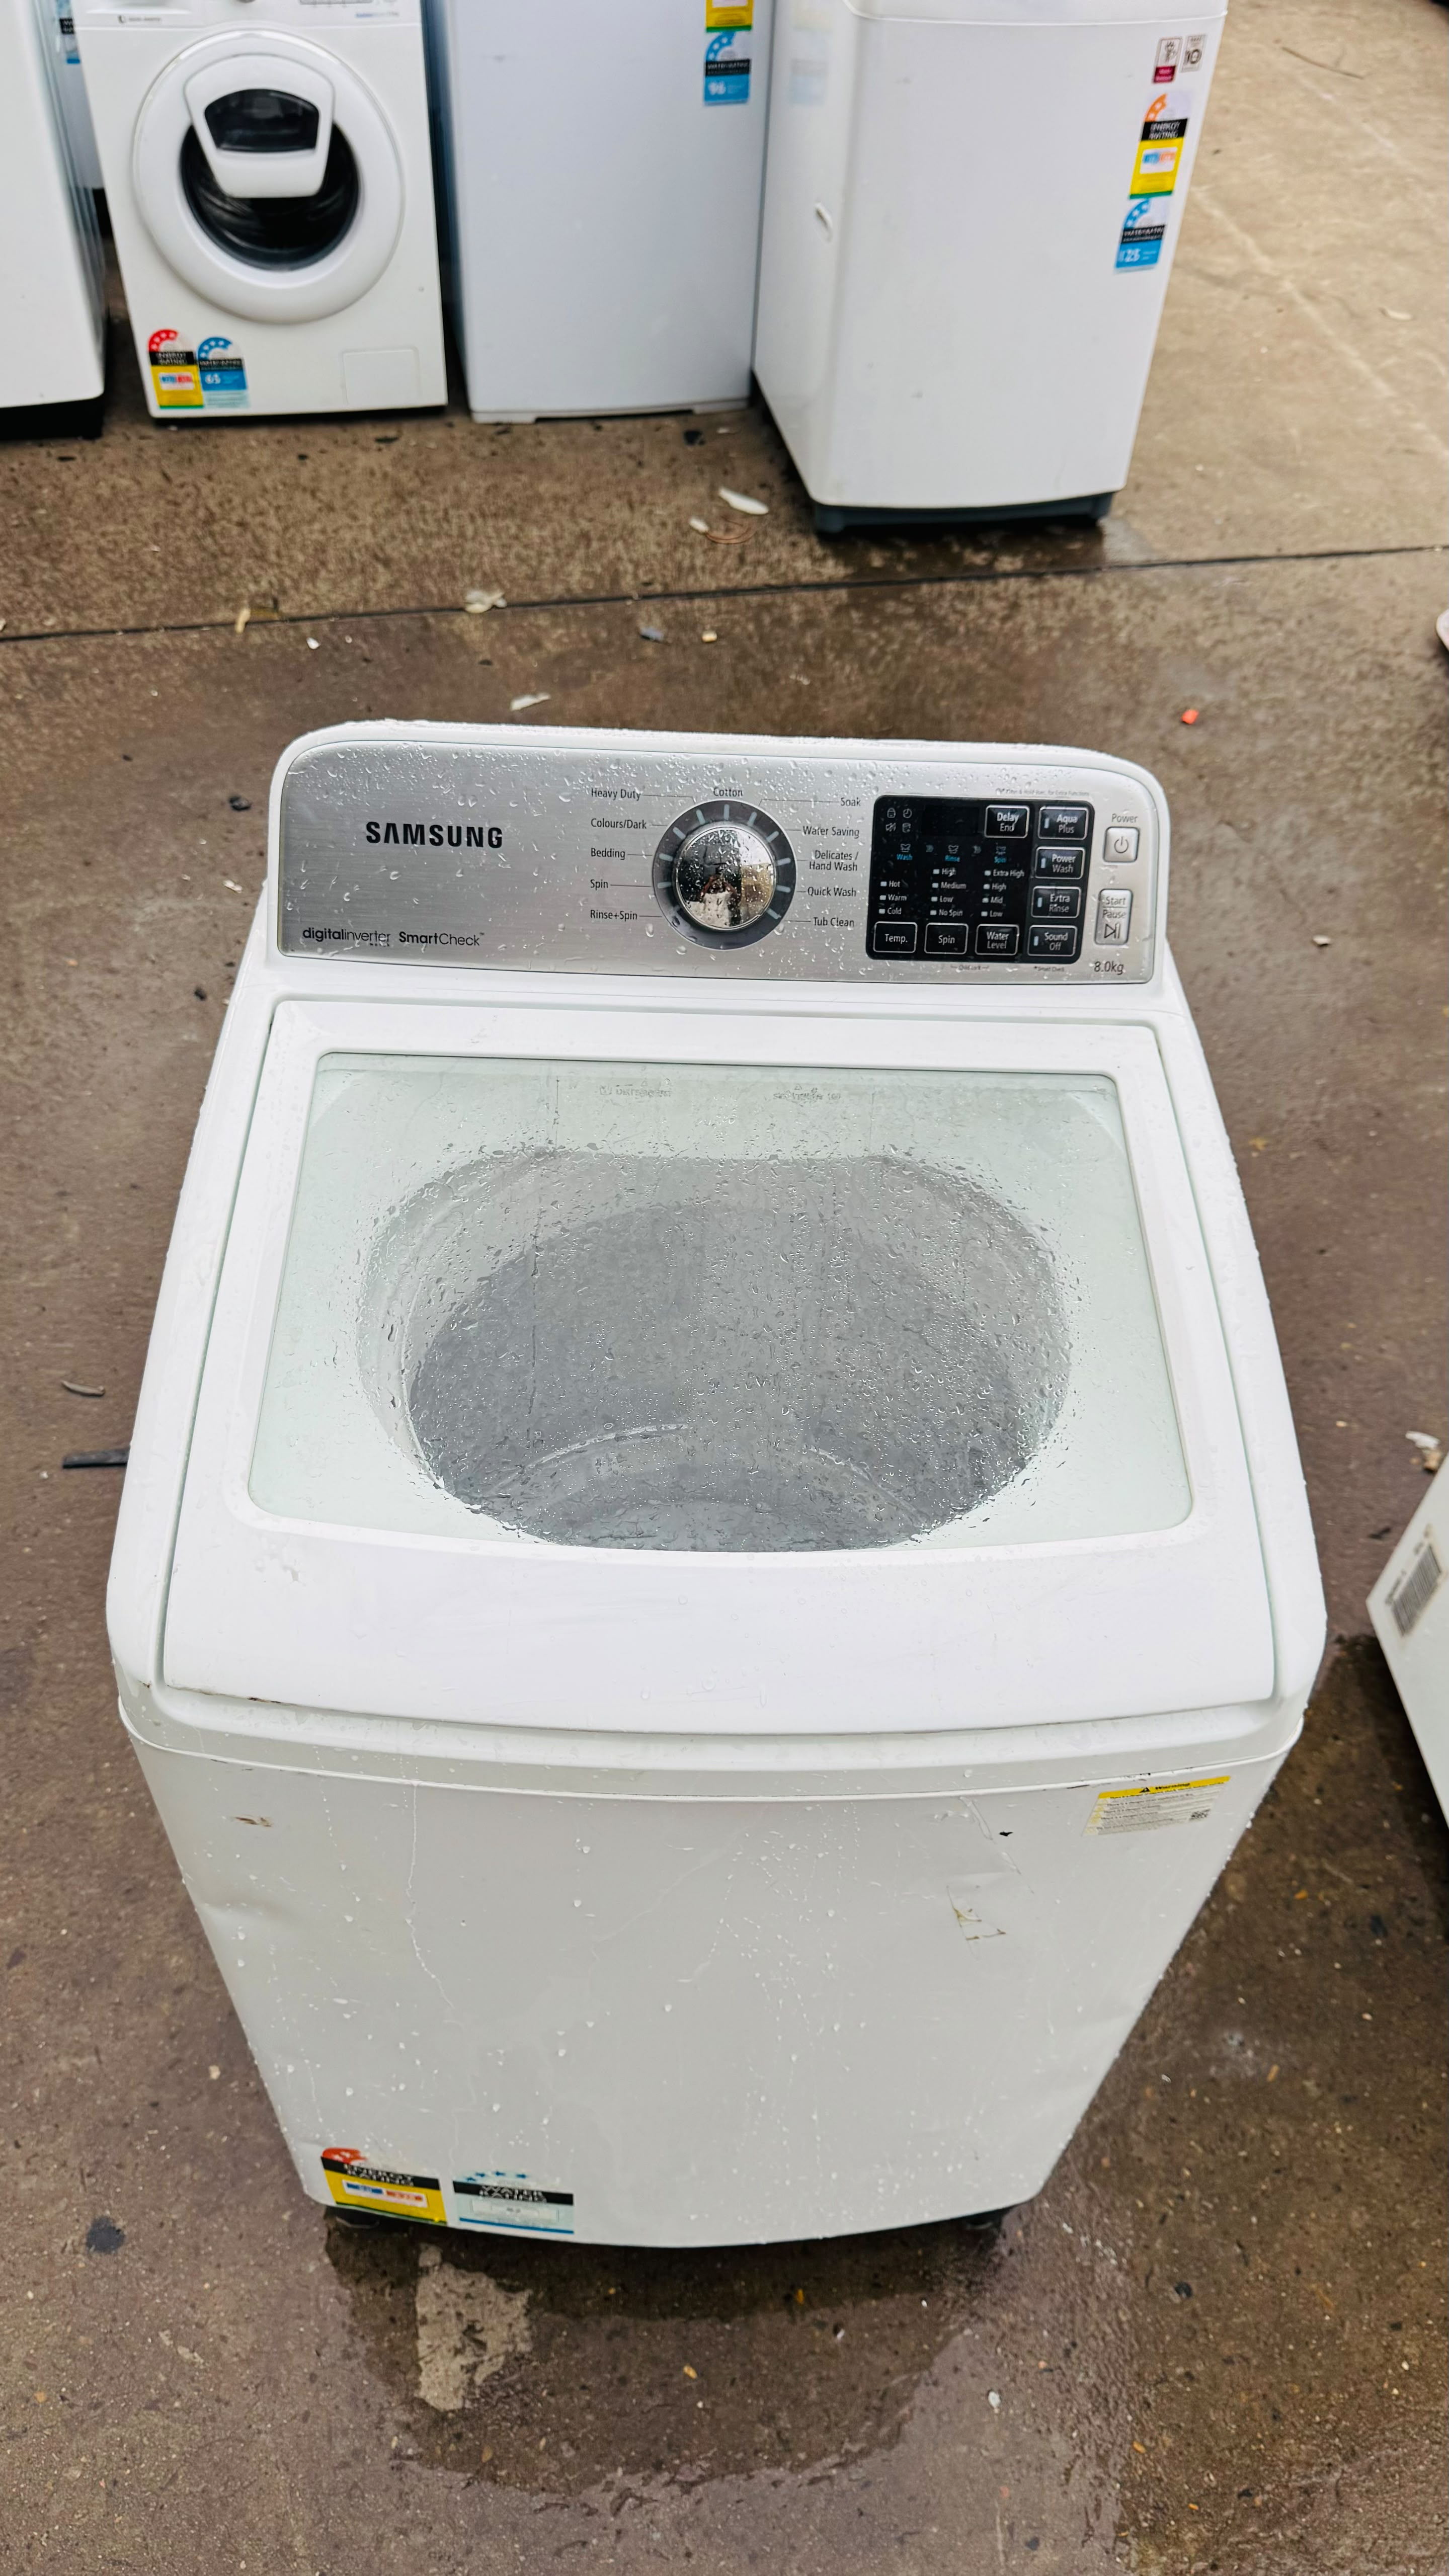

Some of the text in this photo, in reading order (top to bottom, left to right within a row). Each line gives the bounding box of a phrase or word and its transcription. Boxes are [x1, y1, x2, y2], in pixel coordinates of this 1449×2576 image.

[591, 787, 641, 801] Heavy Duty
[713, 787, 743, 797] Cotton
[840, 797, 861, 807] Soak
[997, 812, 1019, 823] Delay
[1056, 814, 1078, 825] Aqua
[1111, 813, 1139, 823] Power
[591, 818, 647, 829] Colours/Dark
[1000, 823, 1015, 832] End
[803, 826, 859, 839] Water Saving
[1058, 825, 1075, 834] Plus
[365, 821, 503, 849] SAMSUNG
[591, 847, 625, 860] Bedding
[815, 850, 852, 860] Delicates
[1052, 854, 1076, 863] Power
[809, 861, 857, 872] Hand Wash
[1053, 864, 1074, 873] Wash
[993, 869, 1025, 878] Extra High
[591, 878, 608, 890] Spin
[992, 883, 1007, 892] High
[808, 886, 856, 897] Quick Wash
[1050, 894, 1071, 903] Extra
[1105, 896, 1126, 905] Start
[949, 909, 963, 918] Spin
[1049, 904, 1070, 913] Rinse
[590, 909, 638, 921] Rinse+Spin
[1102, 910, 1126, 919] Pause
[814, 917, 855, 927] Tub Clean
[885, 934, 908, 944] Temp.
[938, 935, 955, 945] Spin
[986, 931, 1009, 940] Water
[1044, 932, 1069, 941] Sound
[987, 941, 1007, 949] Level
[1049, 942, 1062, 950] Off
[1094, 961, 1124, 975] 8.0kg
